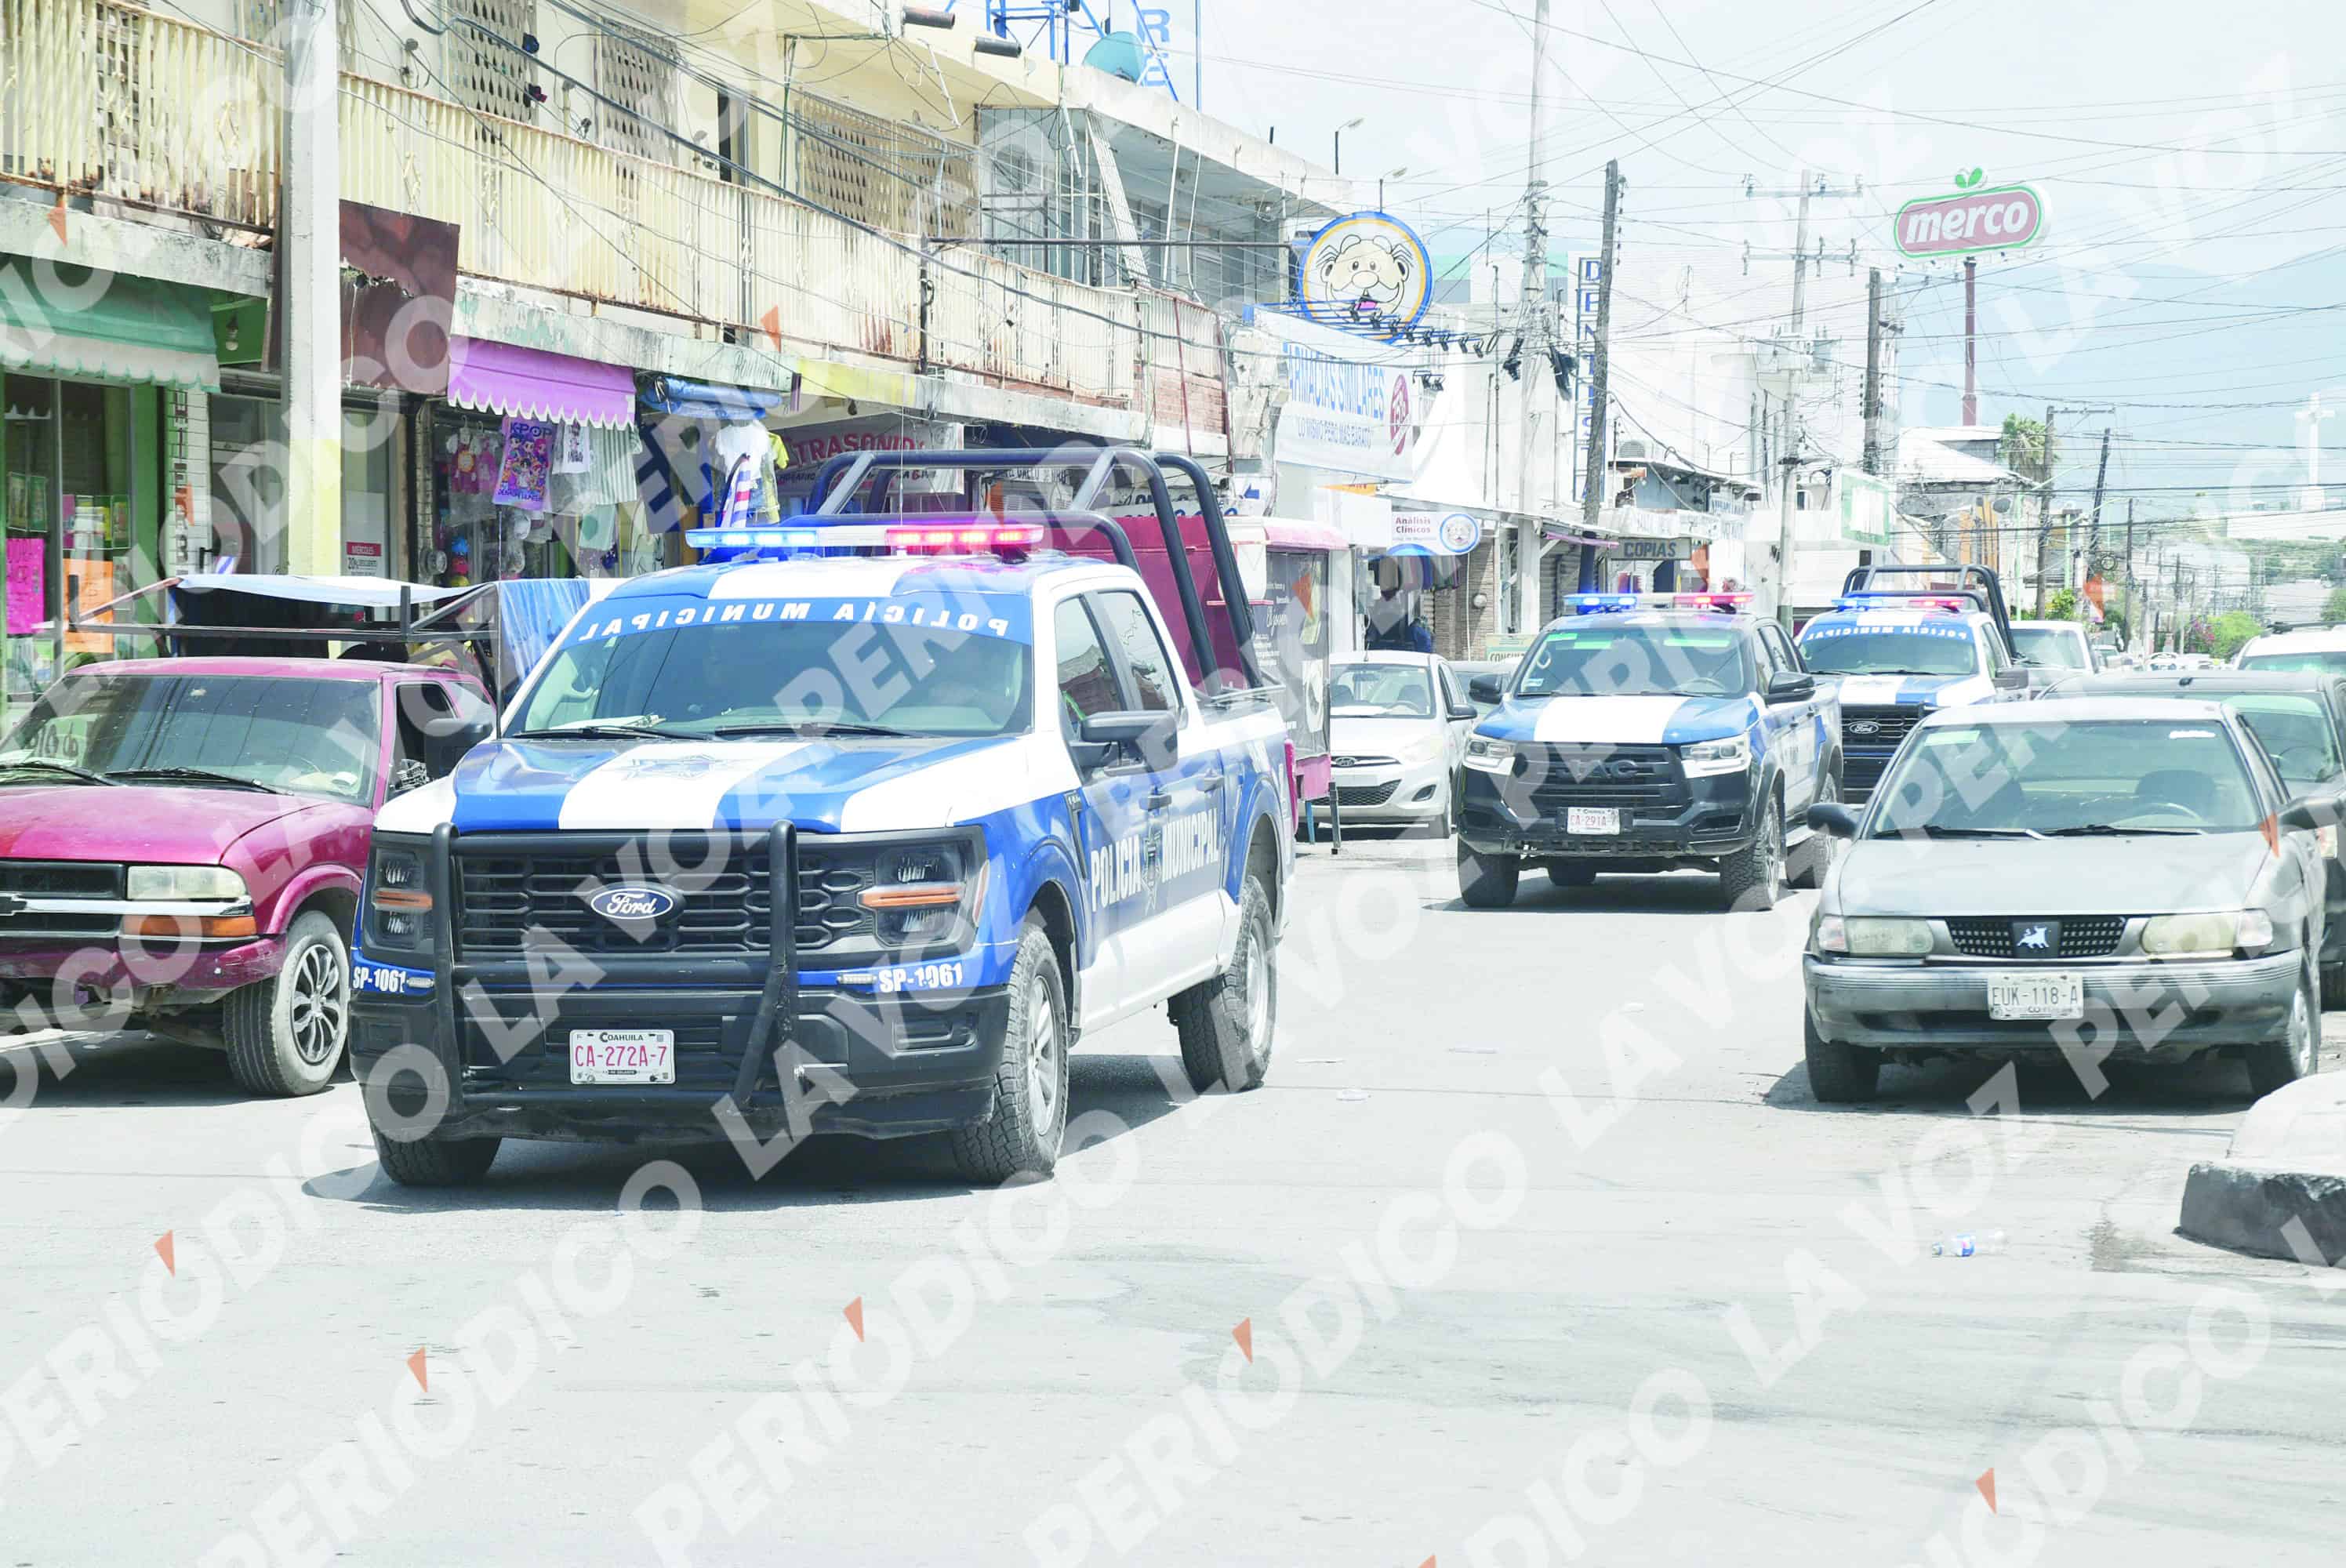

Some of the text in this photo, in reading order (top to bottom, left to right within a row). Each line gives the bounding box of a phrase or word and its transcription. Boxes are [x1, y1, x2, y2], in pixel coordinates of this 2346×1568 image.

[1905, 199, 2029, 245] merco
[1623, 541, 1677, 557] COPIAS
[1090, 807, 1219, 911] POLICIA MUNICIPAL
[352, 965, 406, 993] SP-1061
[879, 962, 964, 993] SP-1061
[1992, 985, 2078, 1007] EUK-118-A
[574, 1044, 668, 1067] CA-272A-7
